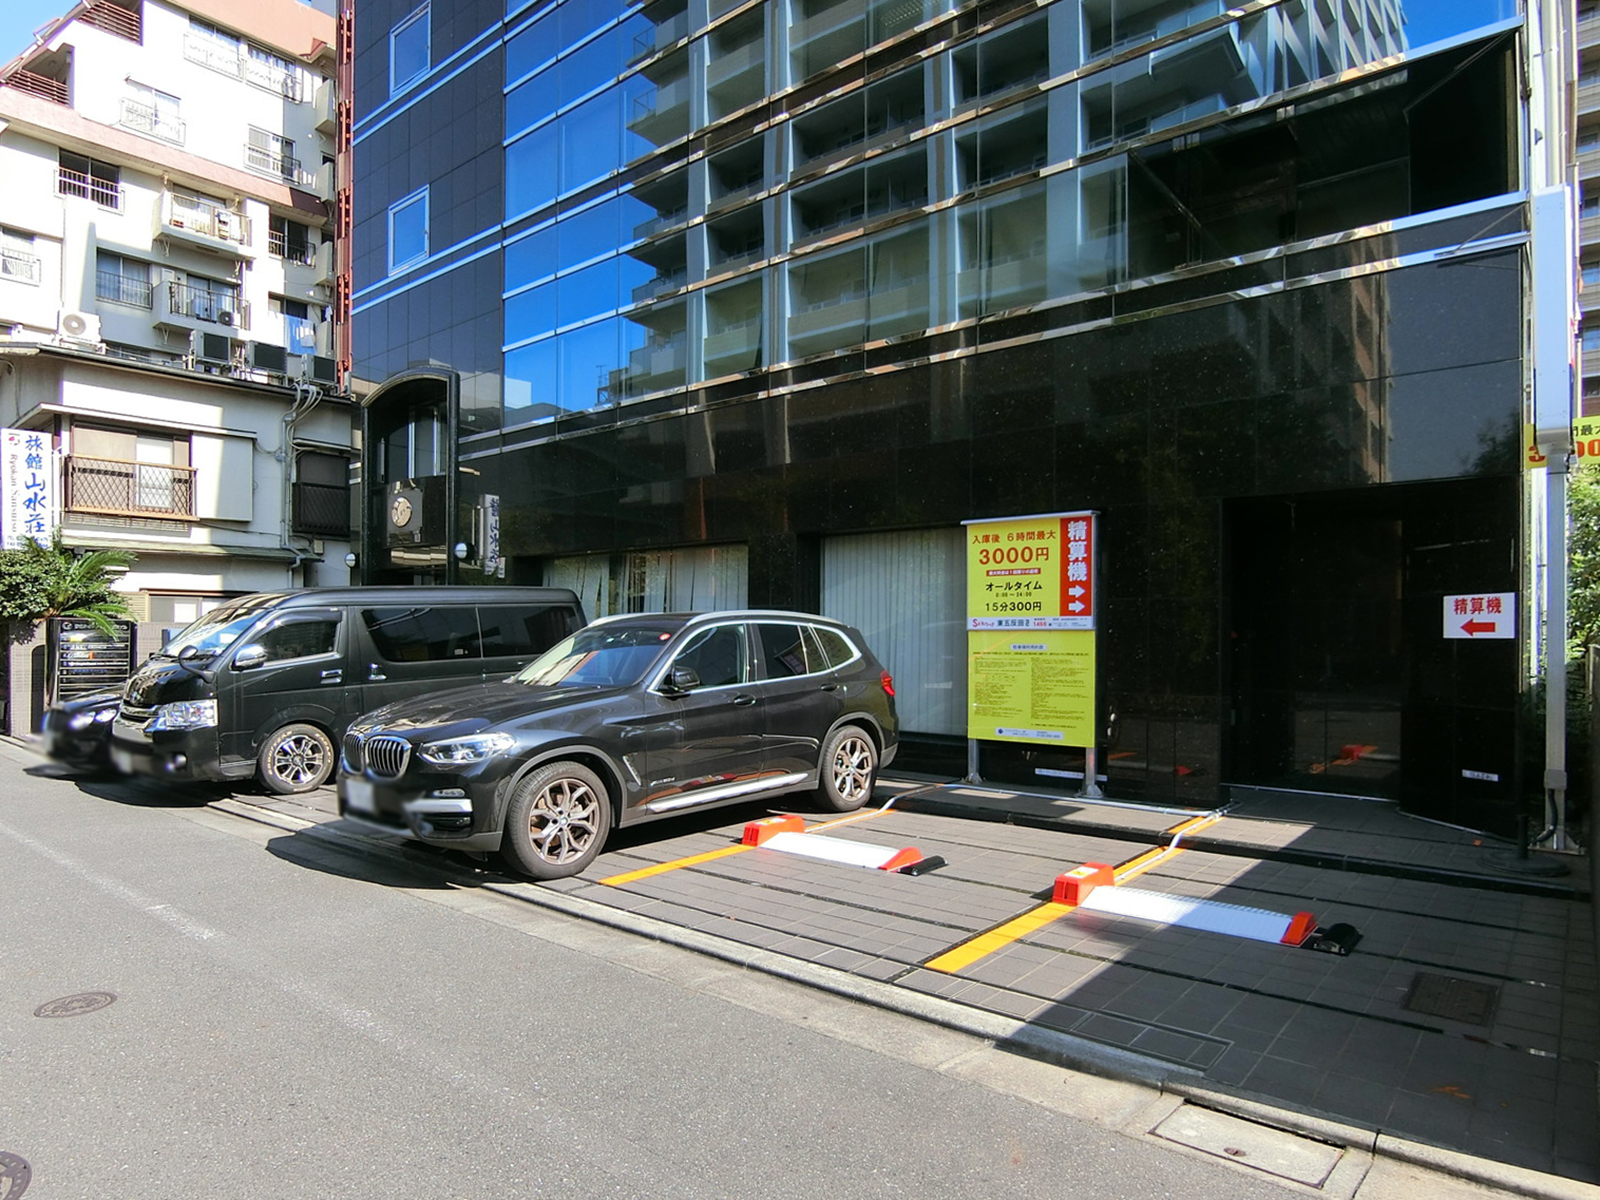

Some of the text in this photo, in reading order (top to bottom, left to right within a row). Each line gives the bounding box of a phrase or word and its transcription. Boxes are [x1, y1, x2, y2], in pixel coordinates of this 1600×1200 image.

[972, 530, 1056, 545] 入庫後 6時間最大
[978, 547, 1050, 565] 3000円
[1067, 520, 1088, 582] 精算機
[985, 581, 1042, 591] オールタイム
[986, 602, 1042, 612] 15分300円
[1453, 597, 1502, 615] 精算機
